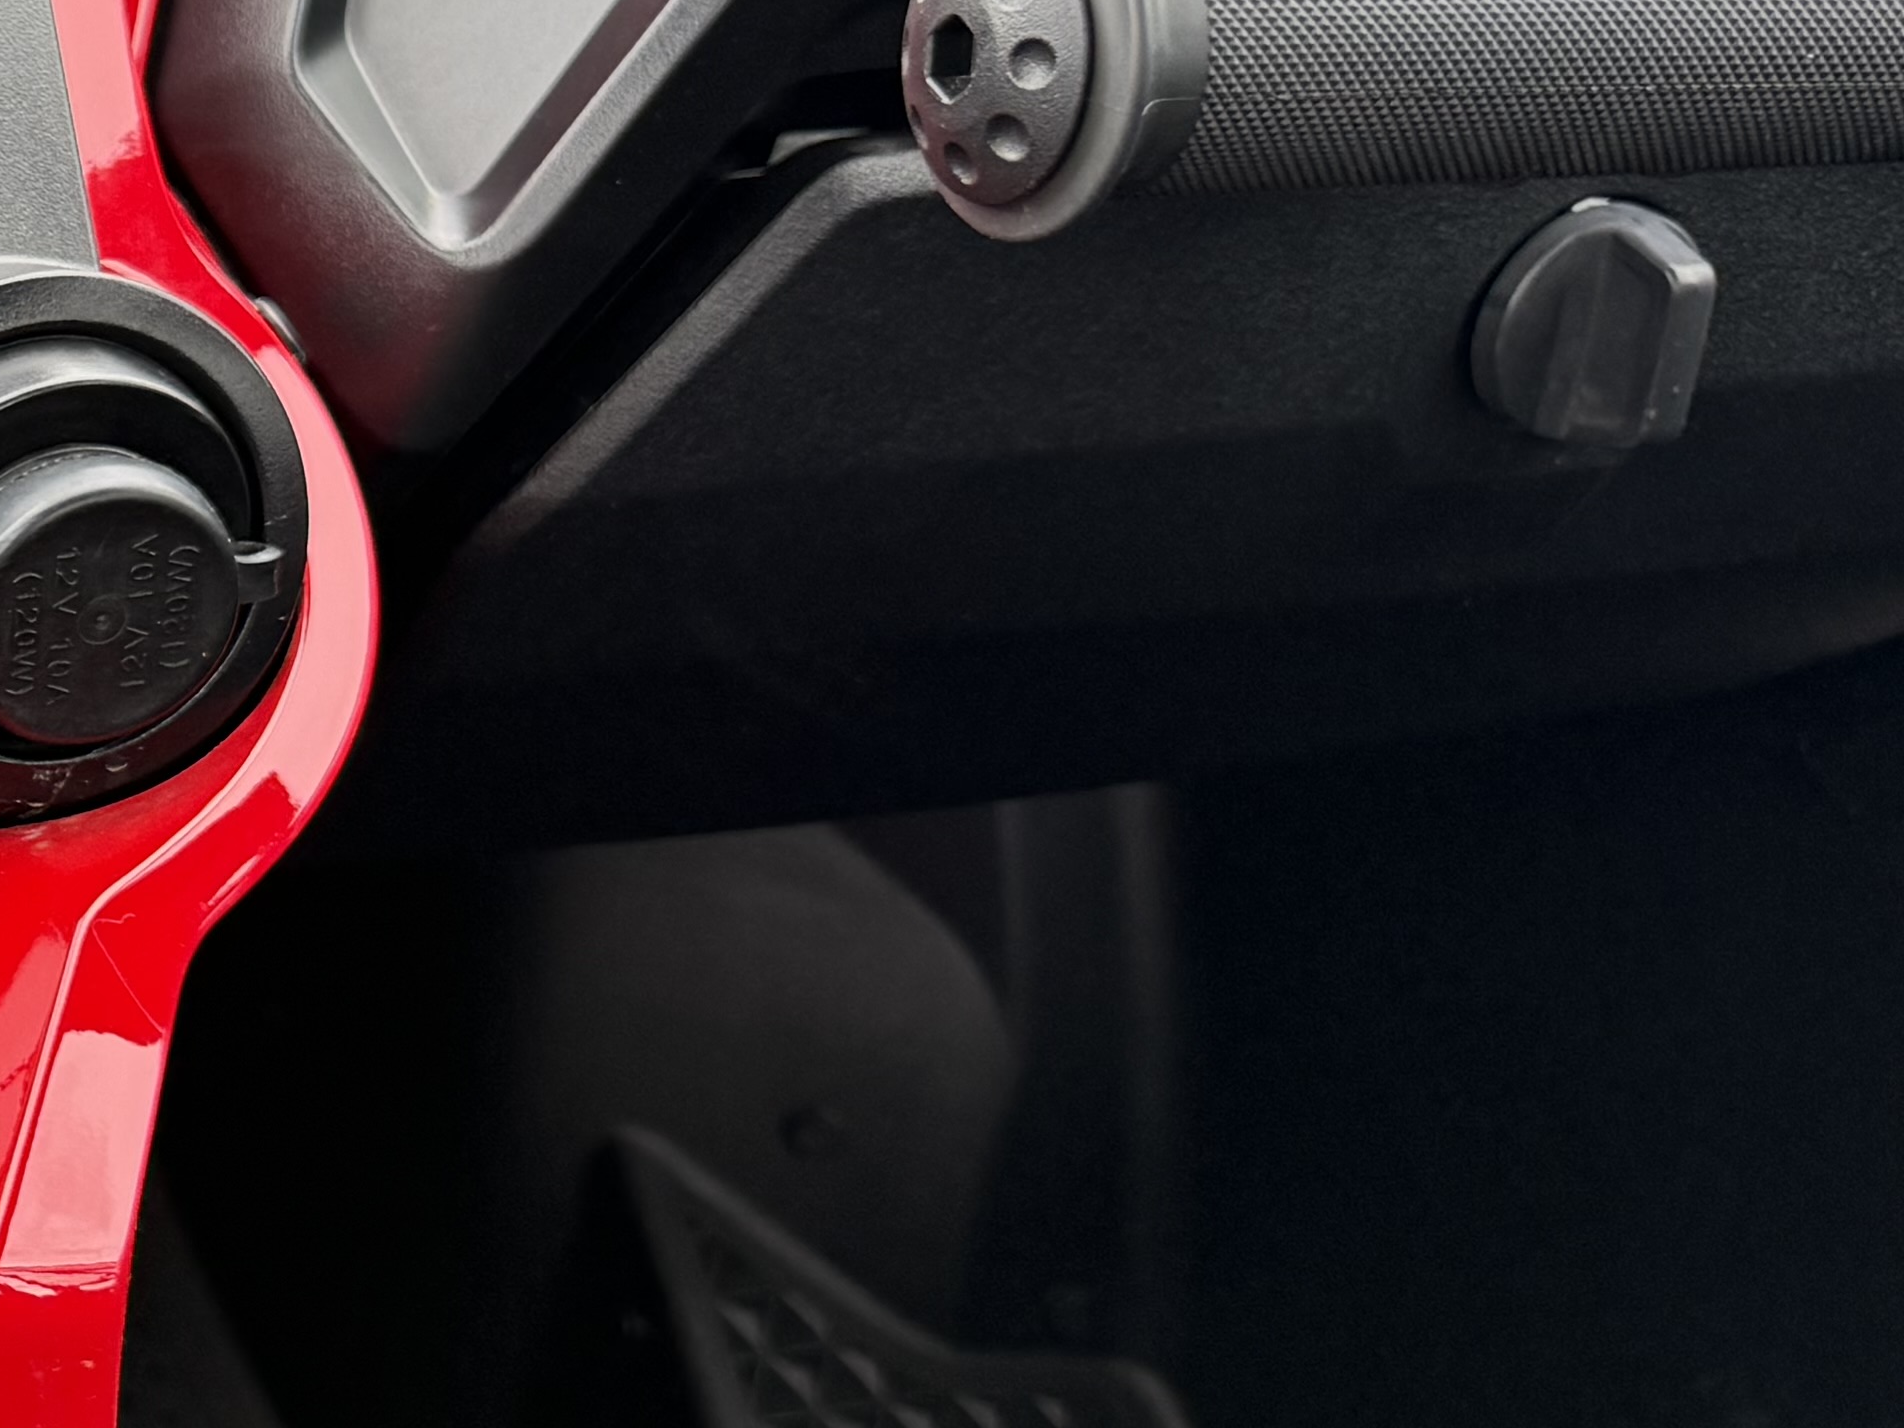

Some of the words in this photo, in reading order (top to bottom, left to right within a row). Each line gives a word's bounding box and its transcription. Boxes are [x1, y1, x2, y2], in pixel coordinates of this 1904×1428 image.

[52, 546, 81, 615] 12V
[5, 572, 43, 695] (120W)
[47, 637, 73, 705] 10A
